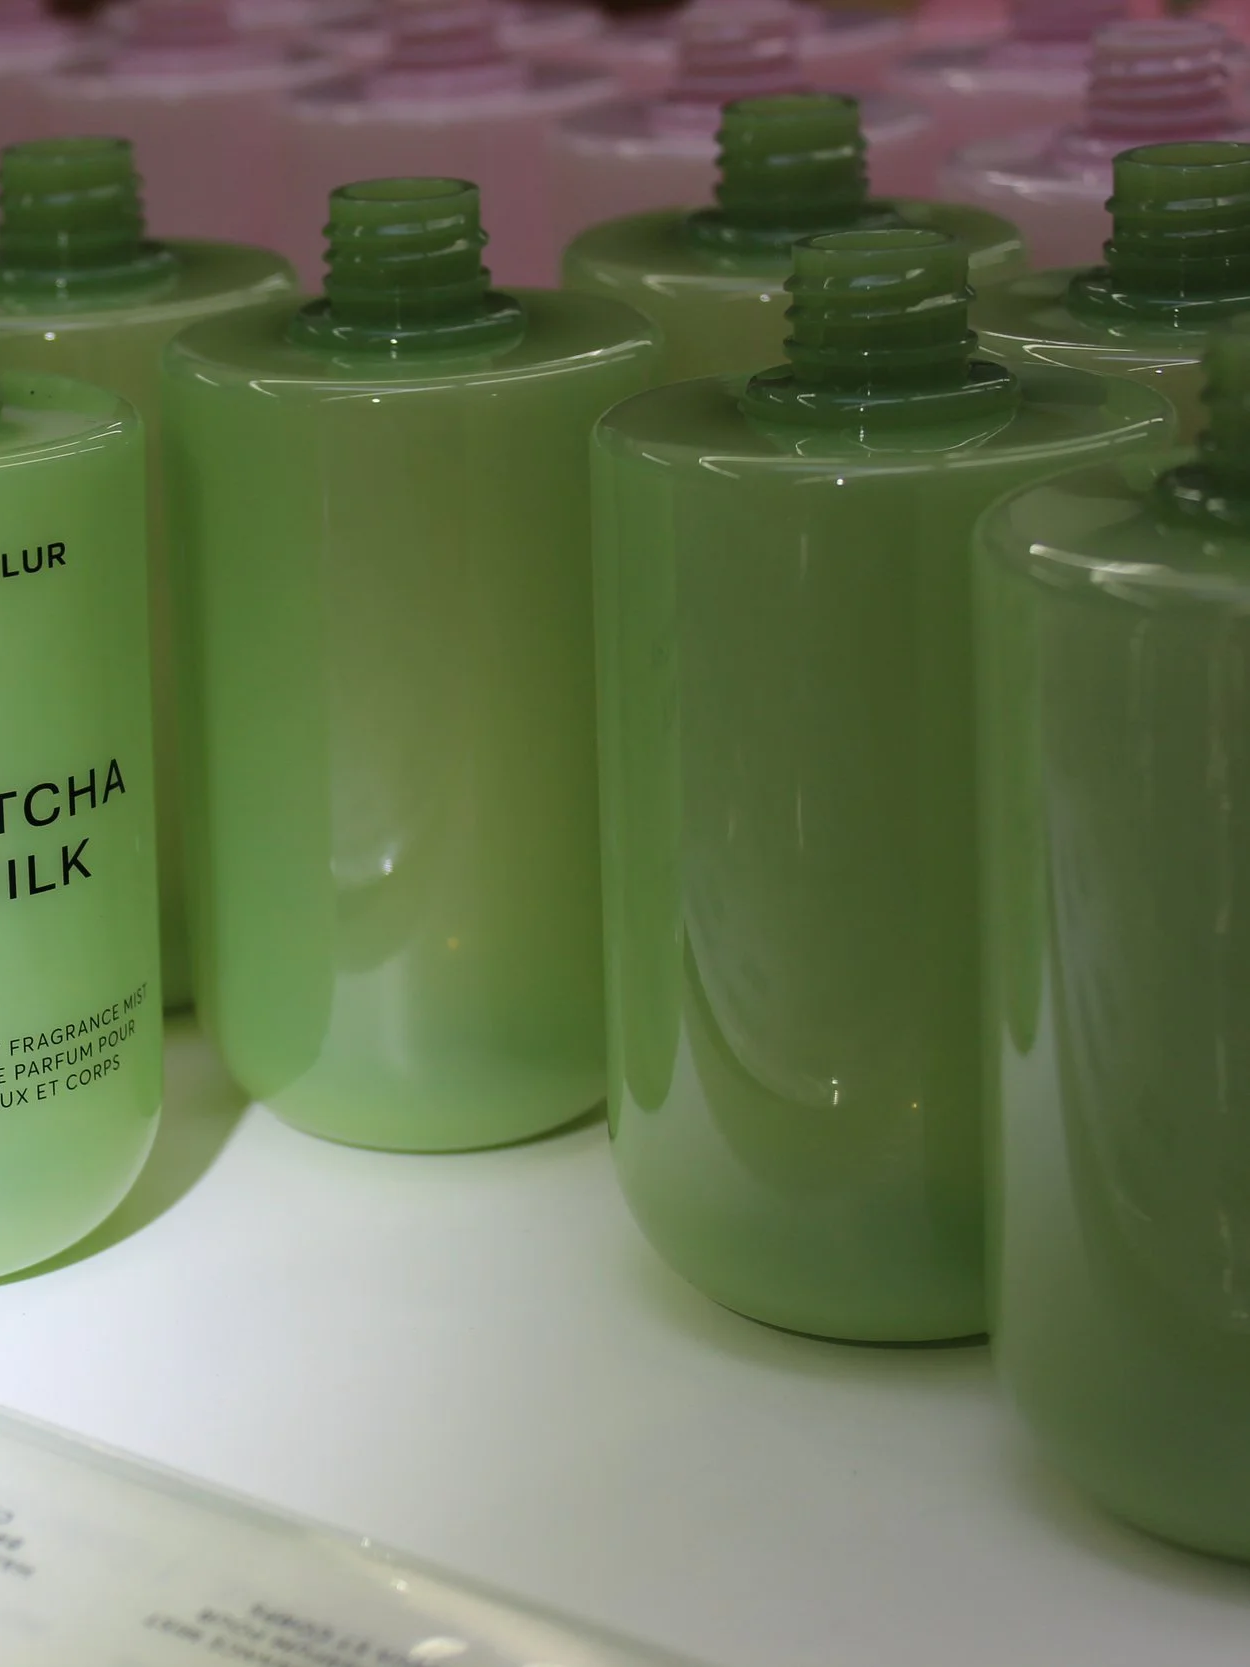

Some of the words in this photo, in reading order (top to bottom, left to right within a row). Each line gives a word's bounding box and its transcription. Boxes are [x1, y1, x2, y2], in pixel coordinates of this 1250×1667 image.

[9, 1003, 120, 1056] FRAGRANCE
[123, 981, 148, 1014] MIST
[14, 1041, 94, 1081] PARFUM
[98, 1019, 136, 1054] POUR
[36, 1079, 59, 1101] ET
[65, 1054, 121, 1091] CORPS
